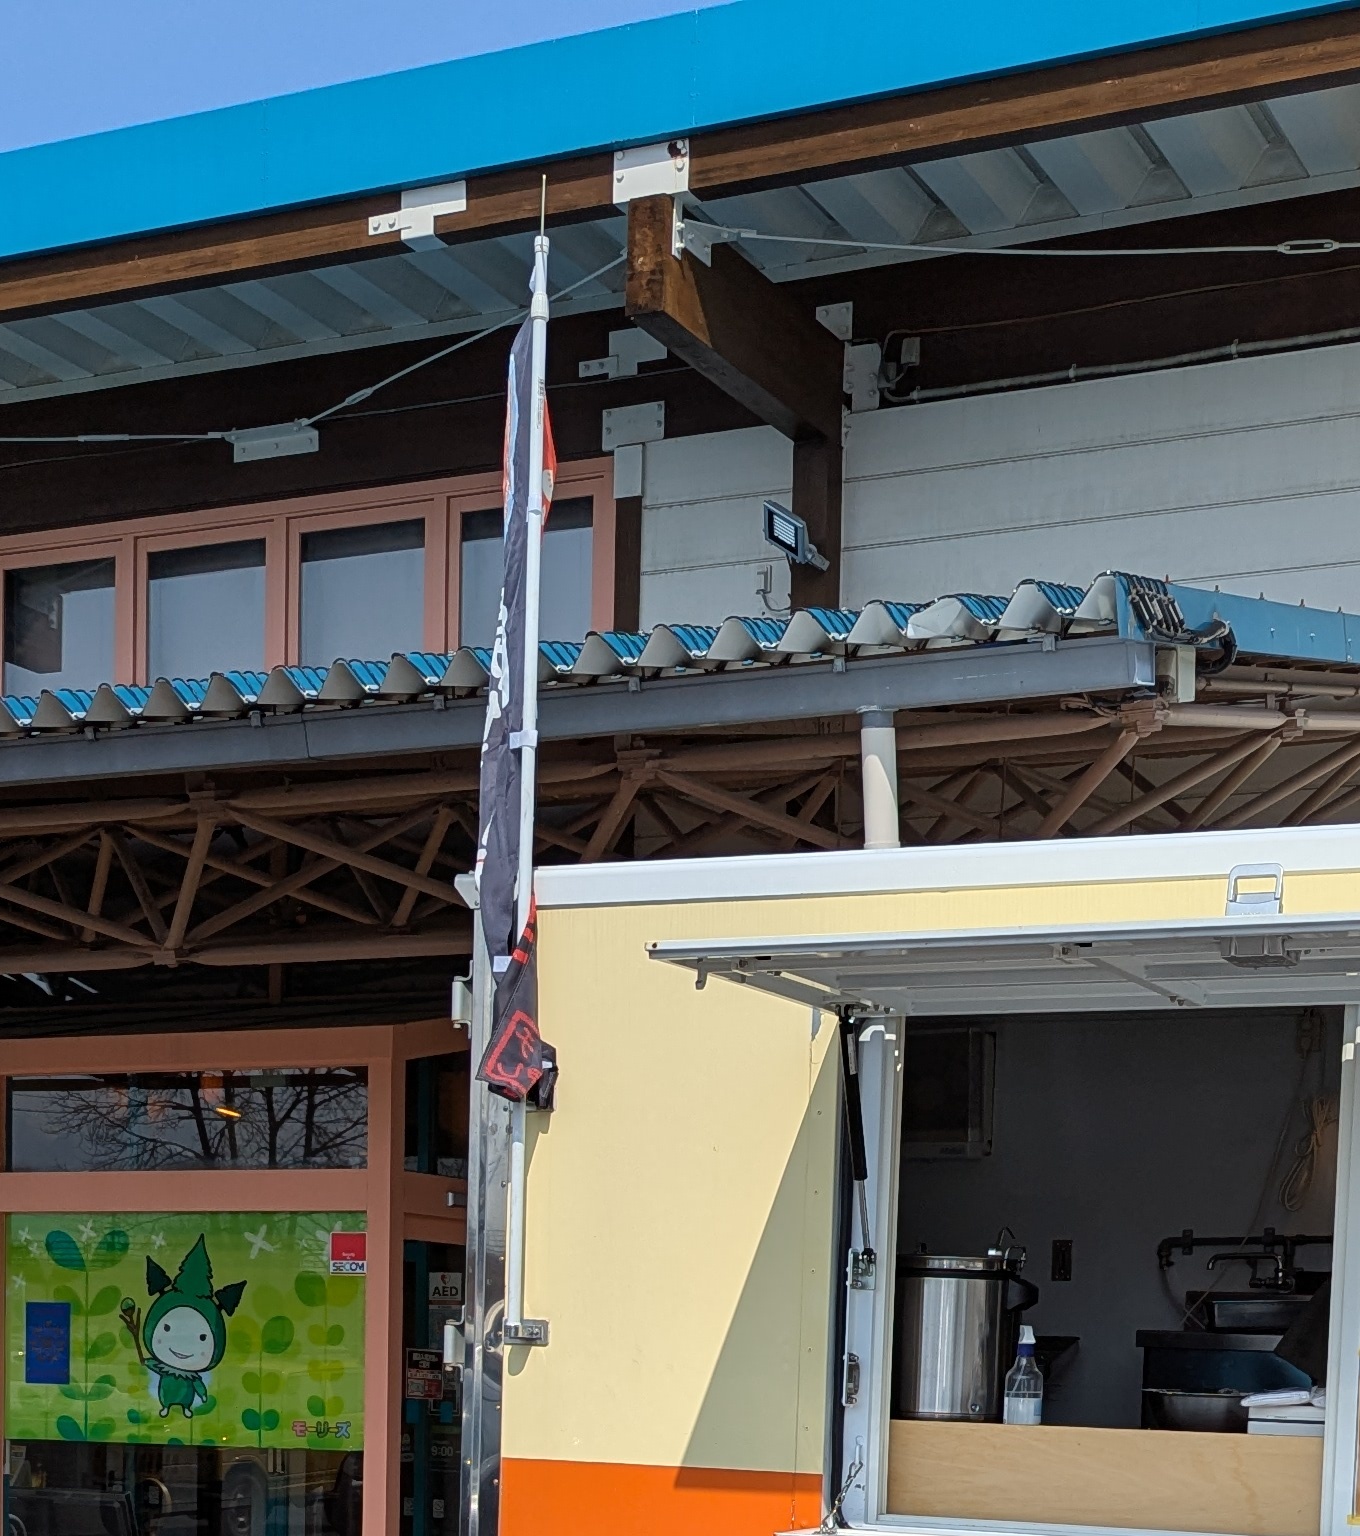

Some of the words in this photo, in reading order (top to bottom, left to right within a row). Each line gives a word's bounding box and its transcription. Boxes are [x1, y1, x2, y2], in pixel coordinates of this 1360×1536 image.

[332, 1261, 365, 1272] SECOM
[432, 1286, 459, 1298] AED
[291, 1420, 352, 1439] モーリーズ
